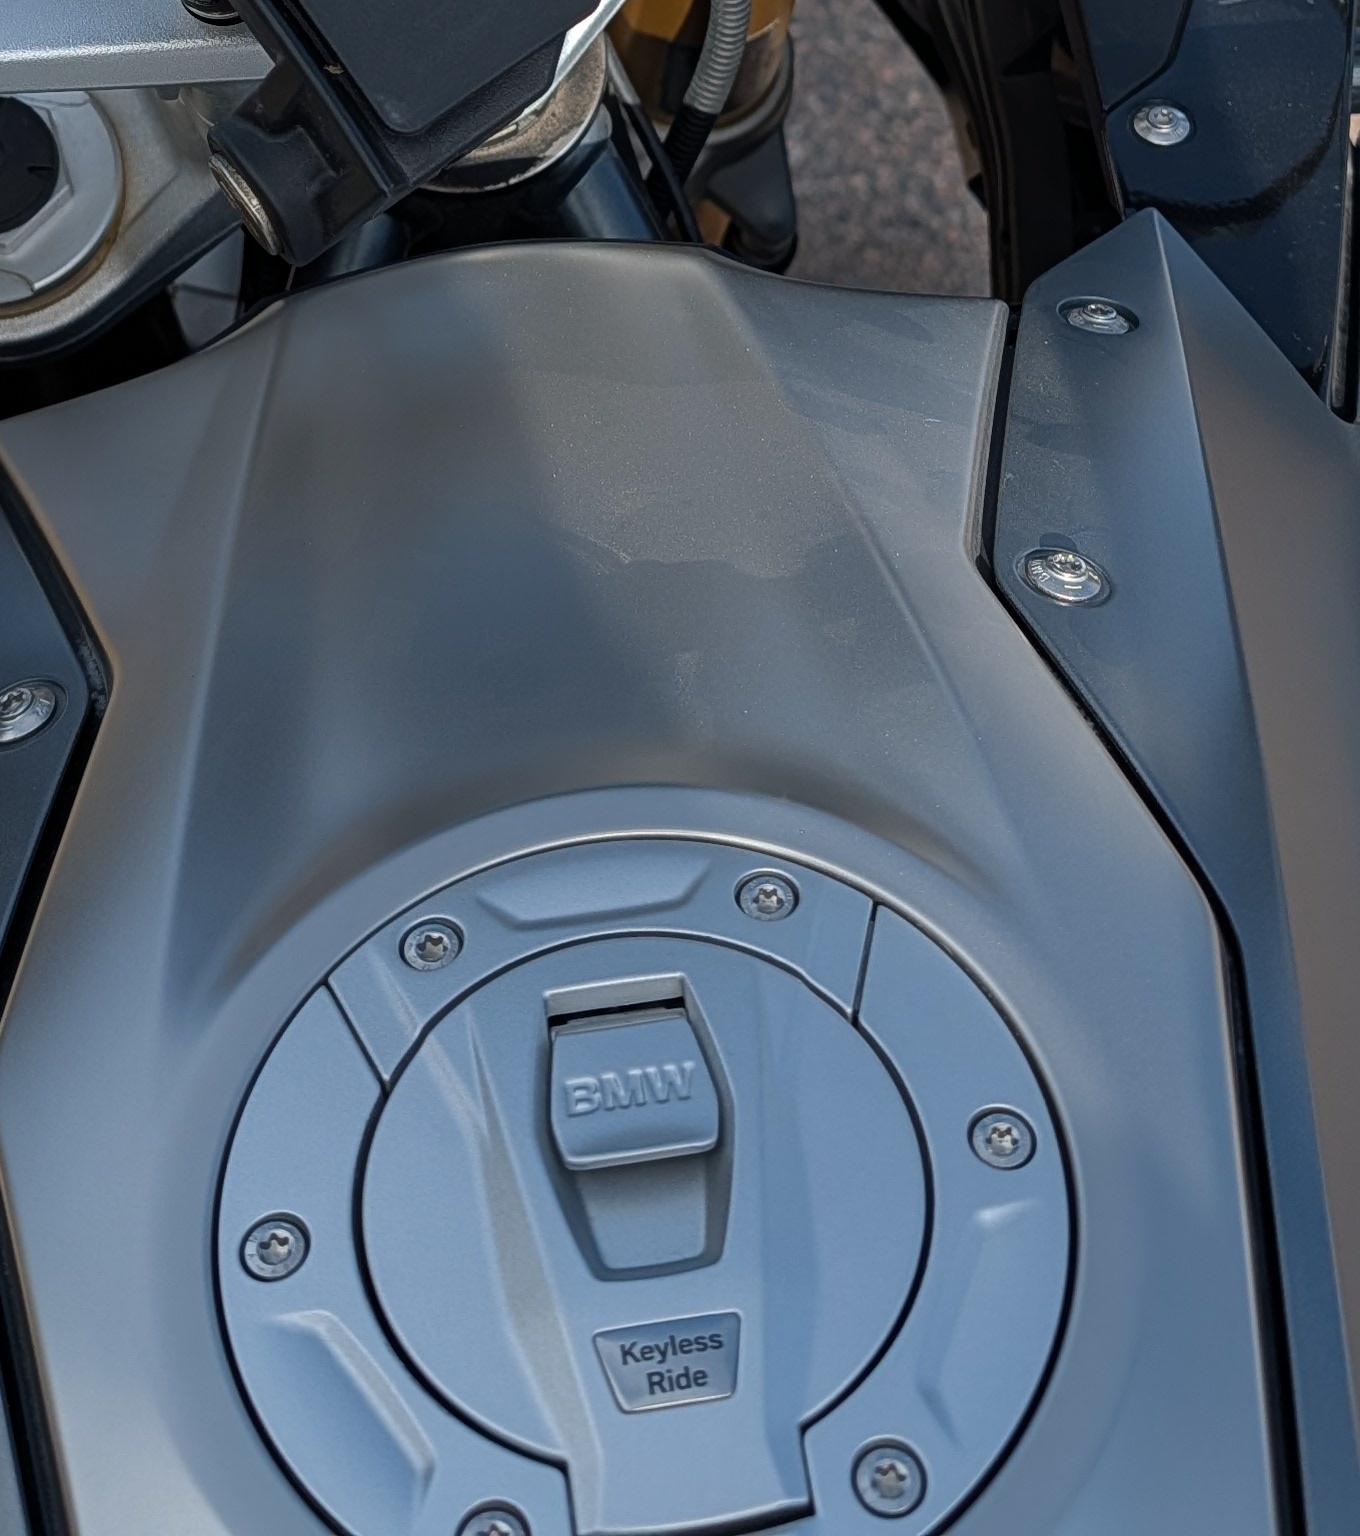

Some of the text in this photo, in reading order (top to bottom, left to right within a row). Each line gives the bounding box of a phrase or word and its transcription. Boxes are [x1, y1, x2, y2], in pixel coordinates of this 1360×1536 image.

[564, 1061, 696, 1117] BMW
[619, 1332, 724, 1366] Keyless
[646, 1367, 709, 1396] Ride
